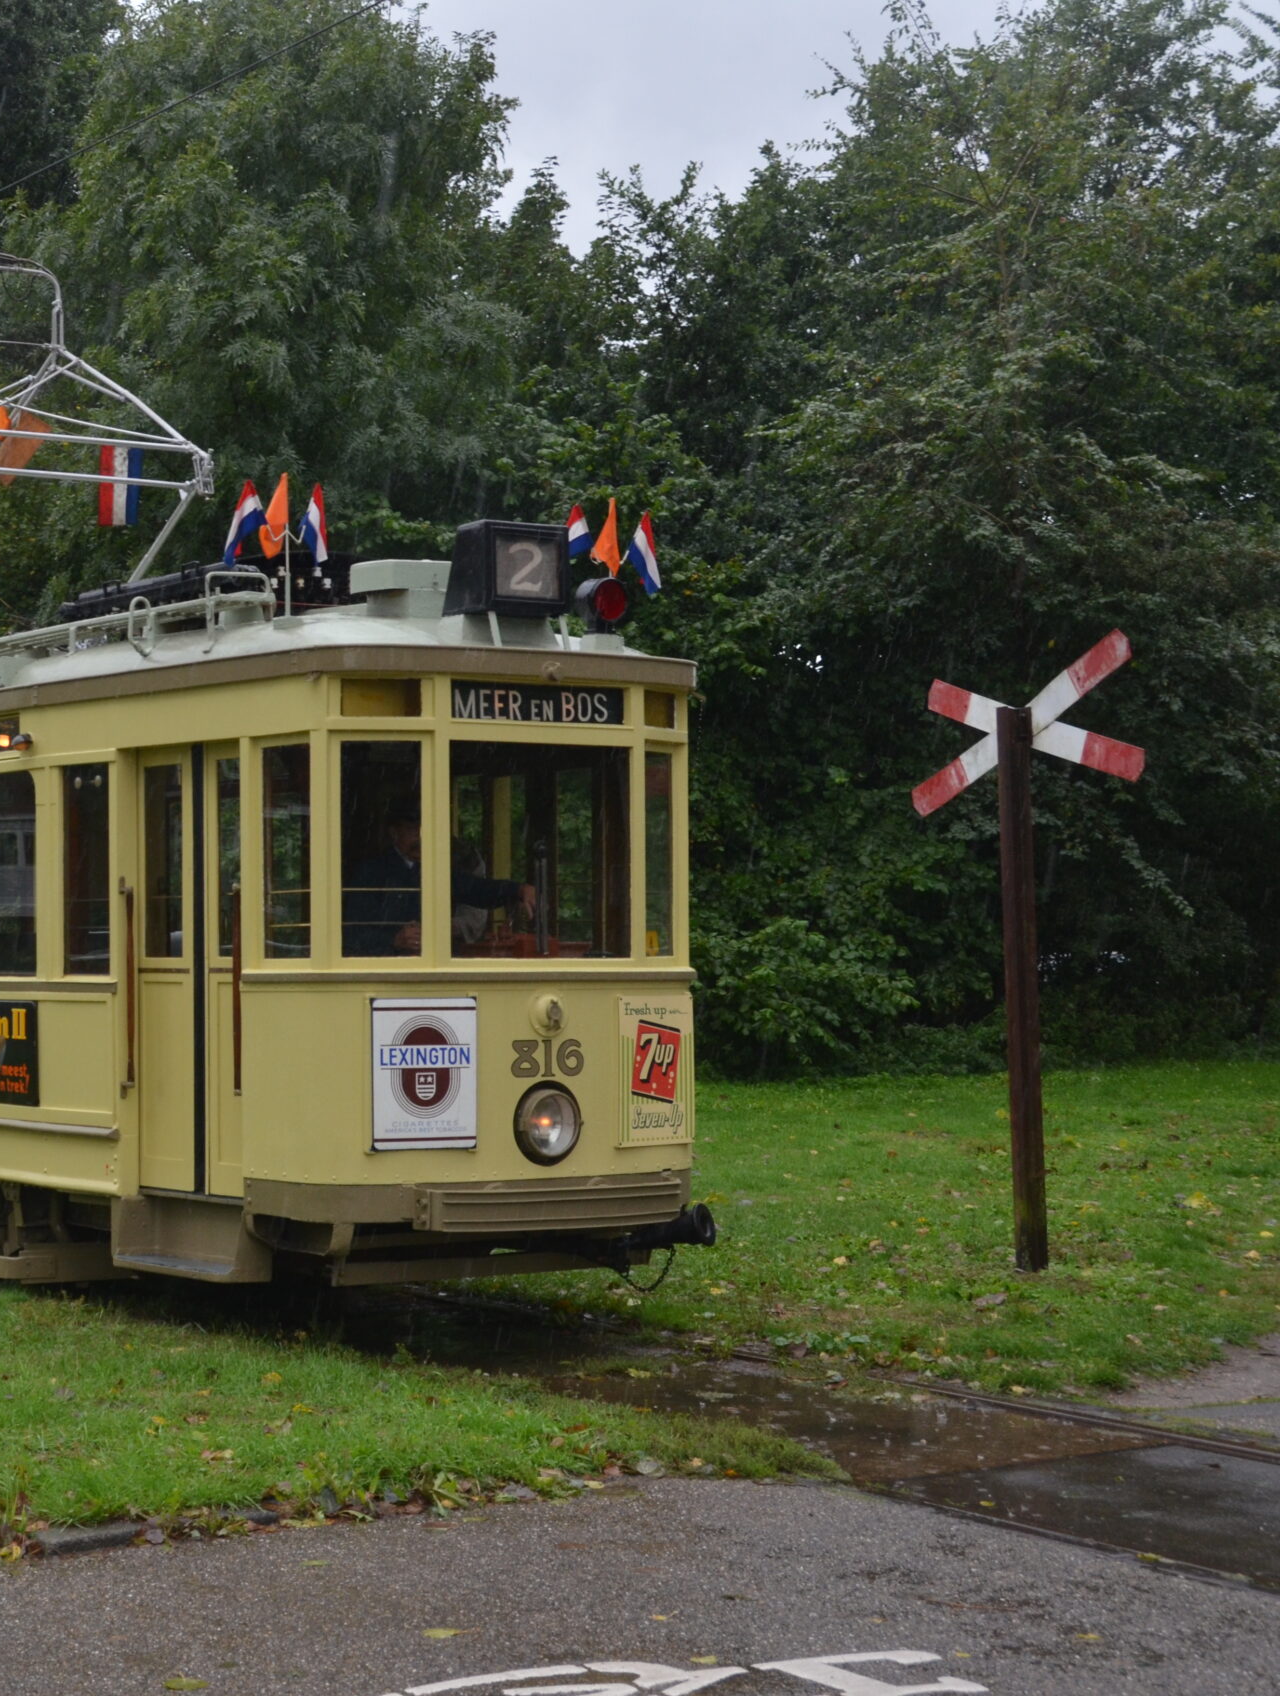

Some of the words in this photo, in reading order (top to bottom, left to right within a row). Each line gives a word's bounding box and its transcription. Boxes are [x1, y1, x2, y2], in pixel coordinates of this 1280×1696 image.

[508, 542, 543, 592] 2
[454, 688, 522, 720] MEER
[531, 700, 553, 721] EN
[561, 691, 608, 722] BOS
[11, 1008, 27, 1040] II
[624, 1002, 651, 1016] fresh
[654, 1007, 667, 1019] up
[380, 1047, 470, 1066] LEXINGTON
[511, 1038, 584, 1078] 816
[632, 1104, 683, 1134] Seven-Up
